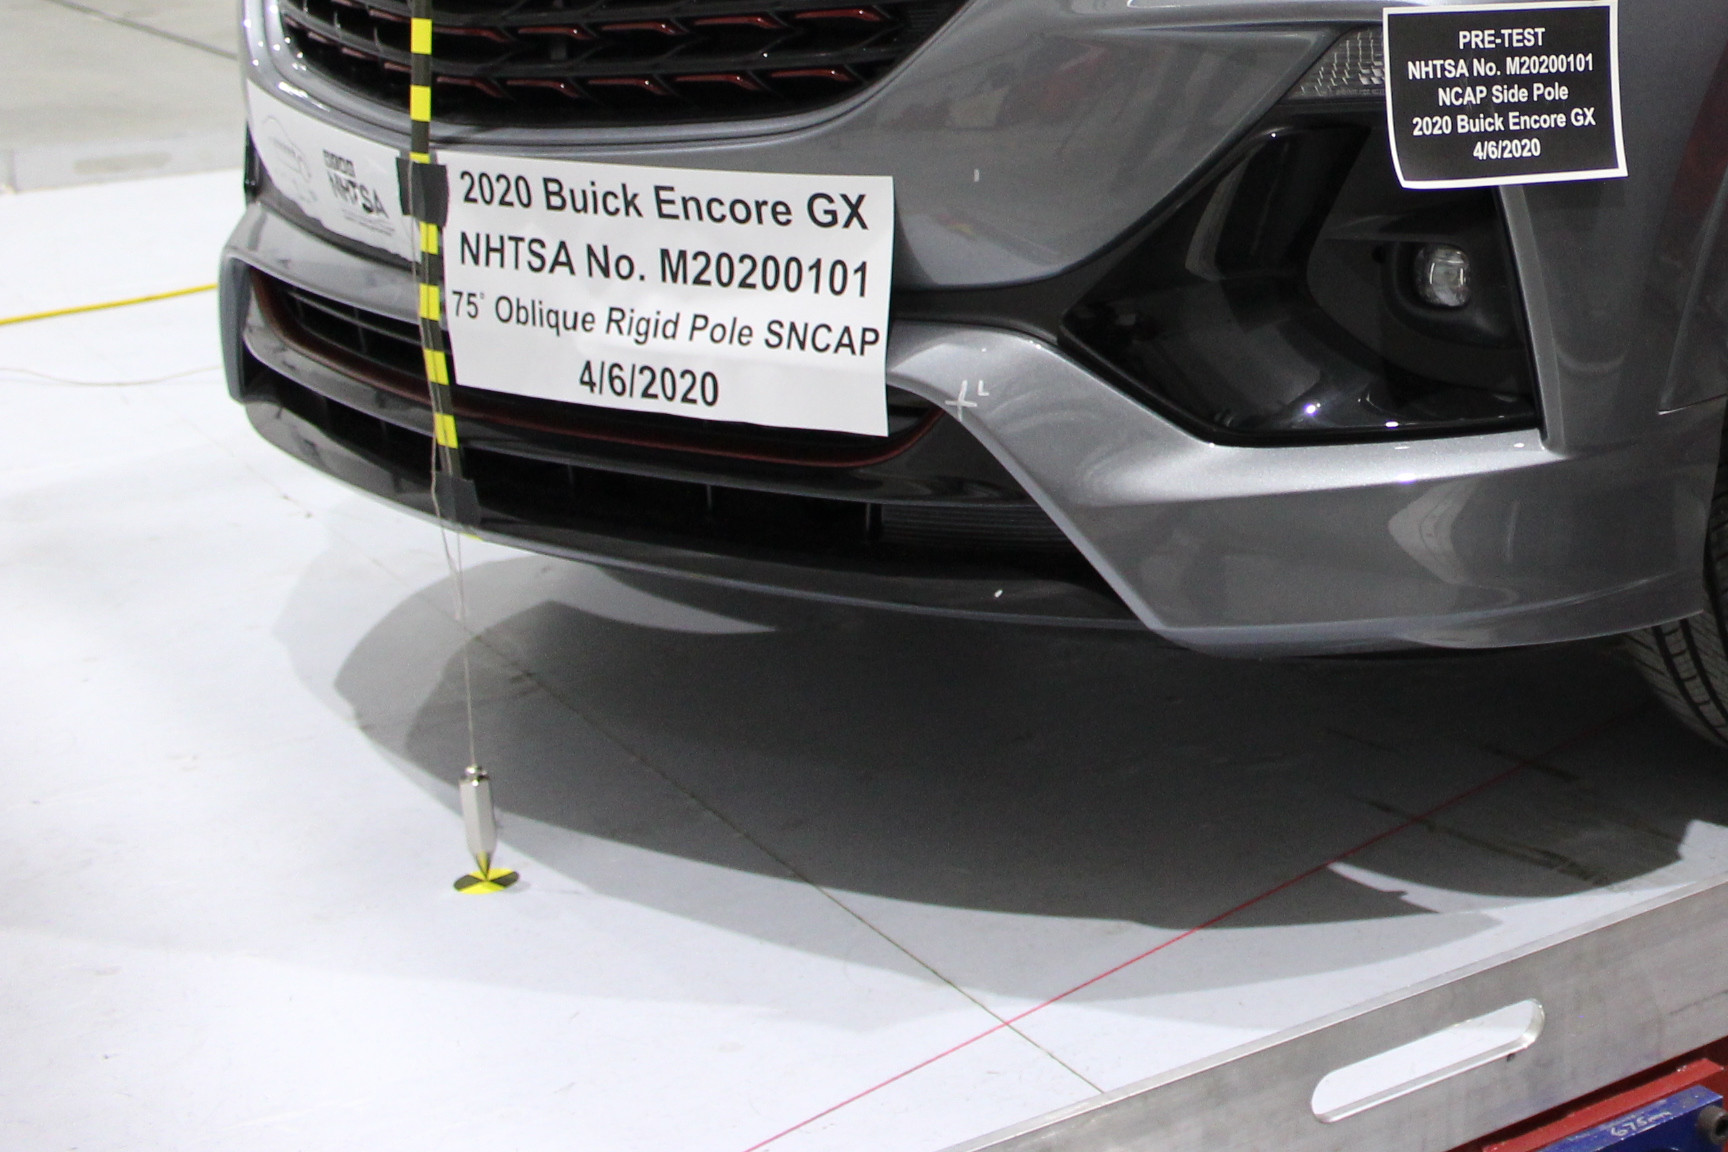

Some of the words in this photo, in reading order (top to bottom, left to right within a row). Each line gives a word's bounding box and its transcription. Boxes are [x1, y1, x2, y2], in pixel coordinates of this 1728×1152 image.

[1459, 28, 1545, 49] PRE-TEST
[1408, 59, 1469, 79] NHTSA
[1473, 58, 1500, 76] No.
[1506, 53, 1594, 75] M20200101
[1438, 86, 1487, 106] NCAP
[1492, 84, 1528, 103] Side
[1533, 82, 1568, 101] Pole
[1413, 116, 1451, 135] 2020
[1457, 113, 1504, 133] Buick
[1509, 112, 1566, 130] Encore
[1571, 107, 1596, 126] GX
[1473, 138, 1540, 160] 4/6/2020
[327, 170, 390, 219] NHTSA
[460, 171, 532, 208] 2020
[543, 177, 643, 217] Buick
[654, 185, 792, 226] Encore
[807, 193, 868, 229] GX
[461, 232, 575, 275] NHTSA
[587, 244, 645, 281] No.
[660, 252, 868, 298] M20200101
[495, 296, 595, 337] Oblique
[606, 307, 680, 345] Rigid
[689, 314, 753, 346] Pole
[765, 320, 879, 356] SNCAP
[580, 360, 718, 406] 4/6/2020
